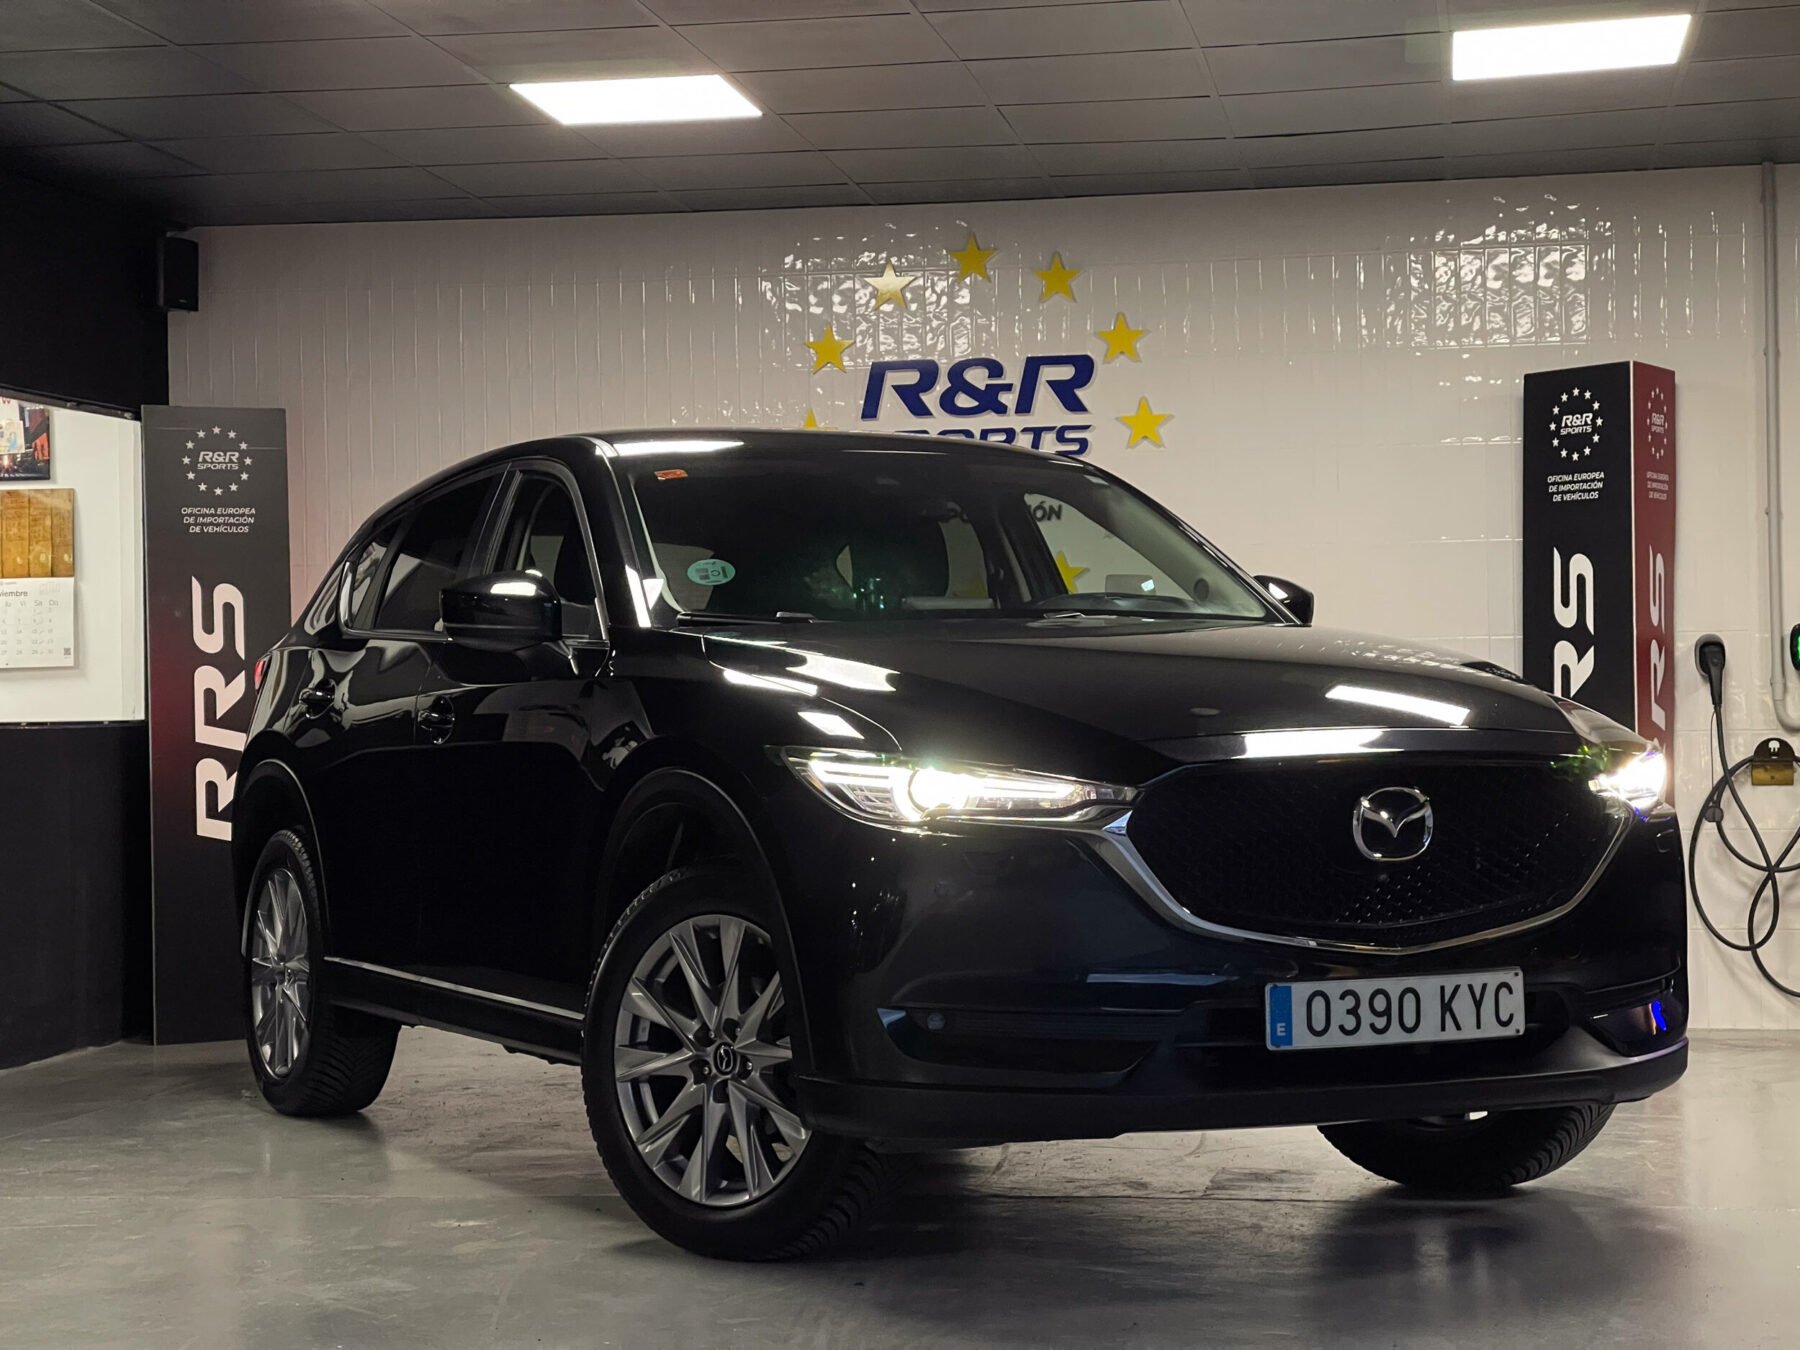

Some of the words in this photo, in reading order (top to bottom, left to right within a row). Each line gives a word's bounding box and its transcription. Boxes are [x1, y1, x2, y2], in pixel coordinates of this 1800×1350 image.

[861, 354, 1095, 420] R&R
[1561, 413, 1593, 427] R&R
[1560, 425, 1592, 435] SPORTS
[198, 451, 239, 463] R&R
[1547, 474, 1573, 483] OFICINA
[1574, 471, 1605, 481] EUROPEA
[1548, 484, 1558, 492] DE
[1559, 481, 1603, 491] IMPORTACIÓN
[1552, 494, 1562, 502] DE
[1563, 491, 1599, 501] VEHÍCULOS
[183, 516, 195, 524] DE
[197, 515, 254, 524] IMPORTACIÓN
[189, 525, 201, 533] DE
[203, 524, 249, 533] VEHÍCULOS
[1649, 544, 1666, 750] RS
[191, 575, 247, 842] RRS
[1306, 986, 1421, 1037] 0390
[1440, 981, 1514, 1032] KYC
[1276, 1023, 1287, 1036] E
